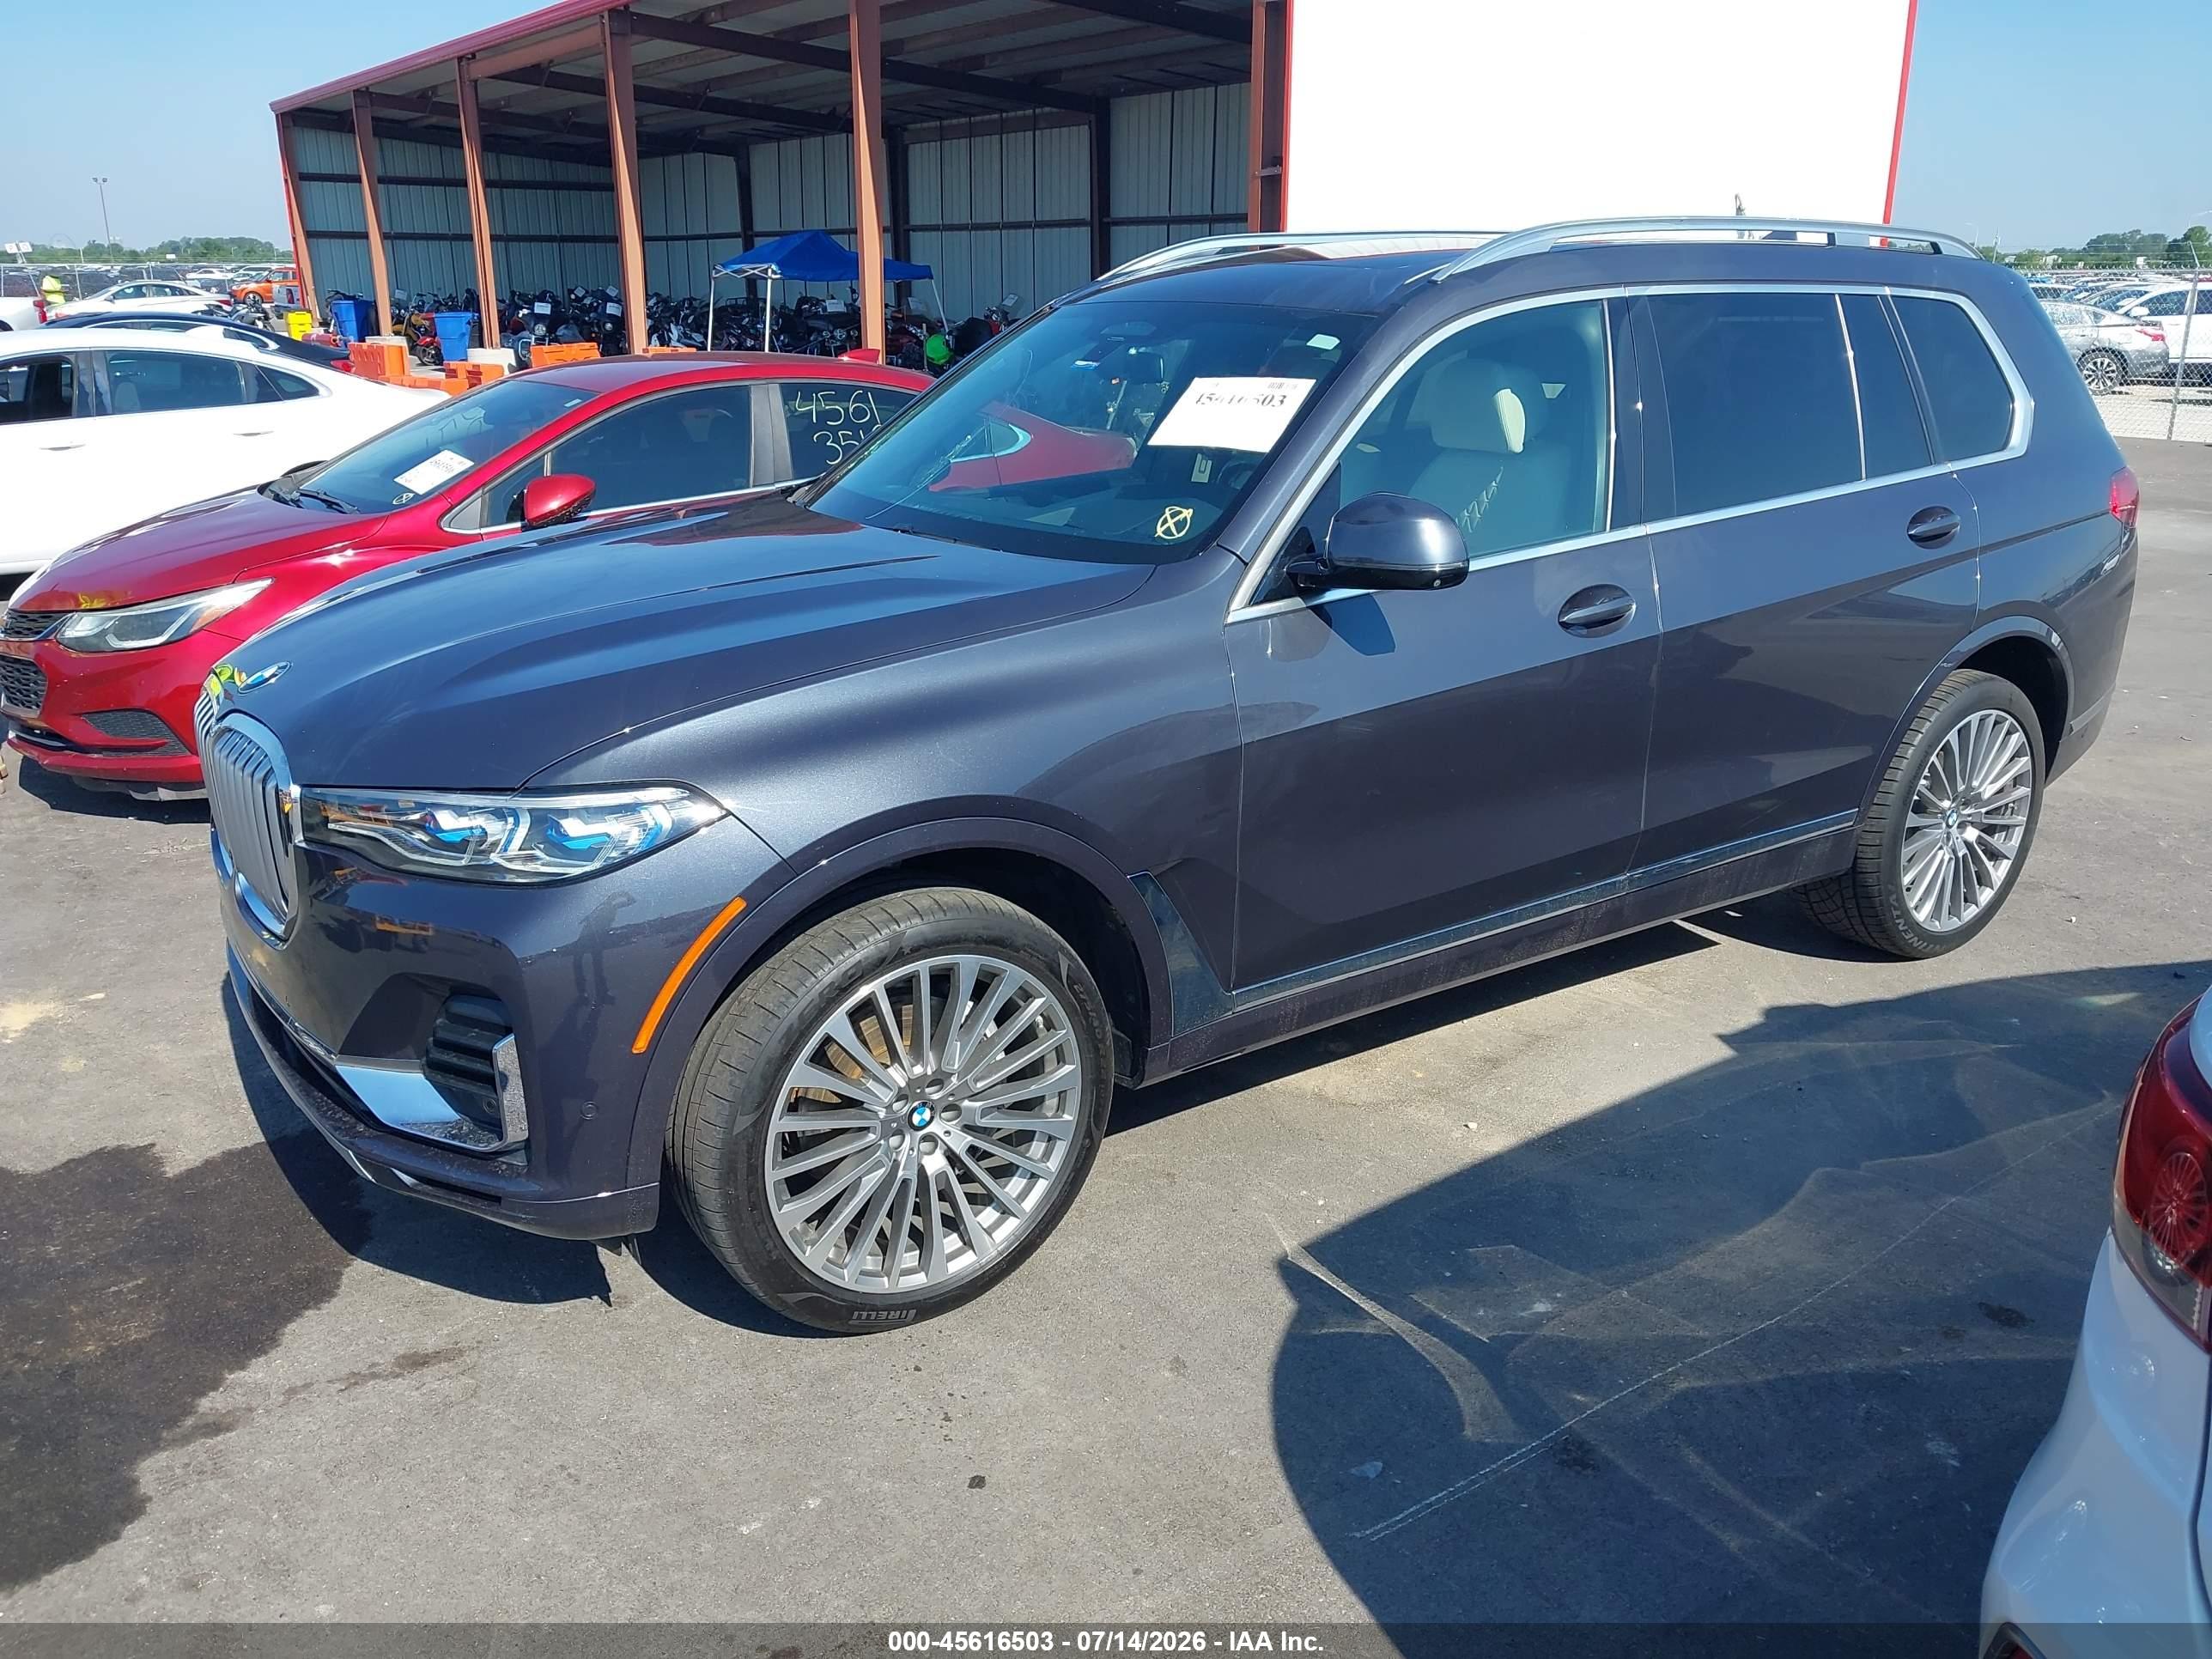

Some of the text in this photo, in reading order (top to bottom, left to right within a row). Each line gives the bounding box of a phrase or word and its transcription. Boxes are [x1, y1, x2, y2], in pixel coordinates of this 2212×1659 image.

[795, 390, 881, 426] 4561
[813, 424, 882, 465] 35
[852, 1309, 916, 1323] PIRELLI
